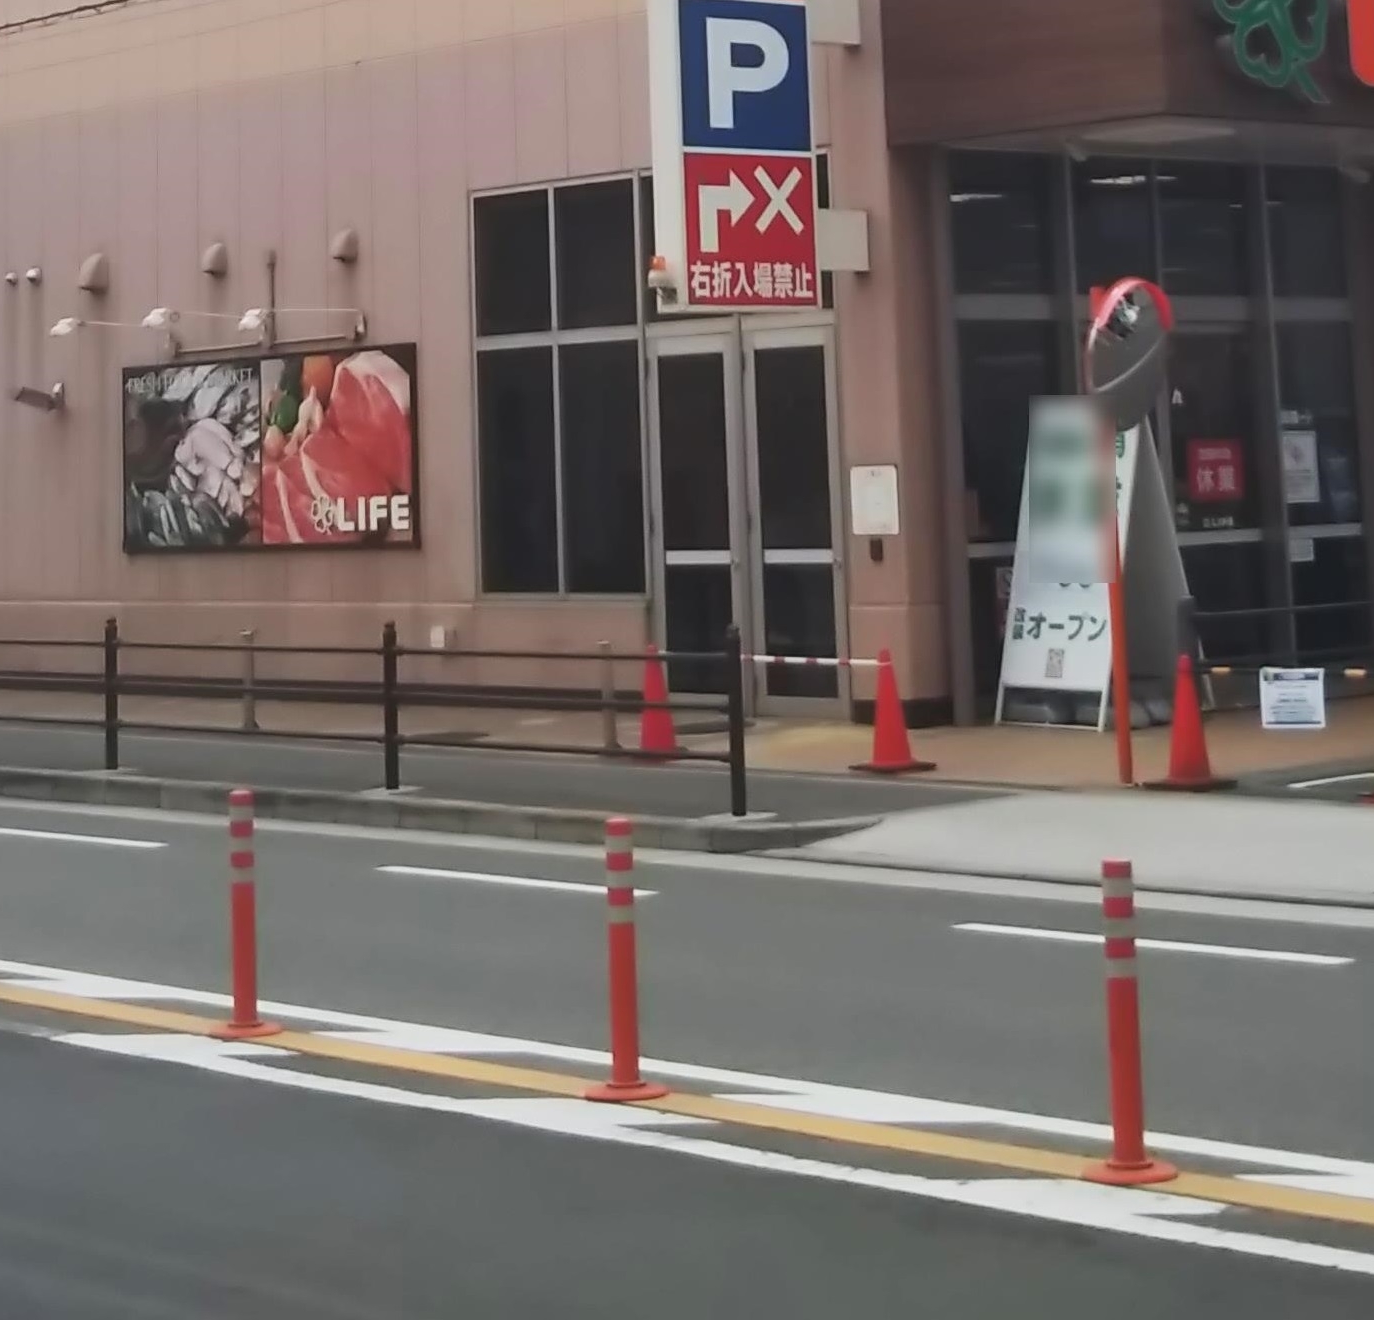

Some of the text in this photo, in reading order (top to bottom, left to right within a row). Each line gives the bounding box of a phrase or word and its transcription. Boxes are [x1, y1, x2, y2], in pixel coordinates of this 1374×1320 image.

[706, 16, 790, 130] P
[690, 260, 814, 299] 右折入場禁止
[336, 494, 410, 532] LIFE
[1027, 612, 1107, 641] オープン
